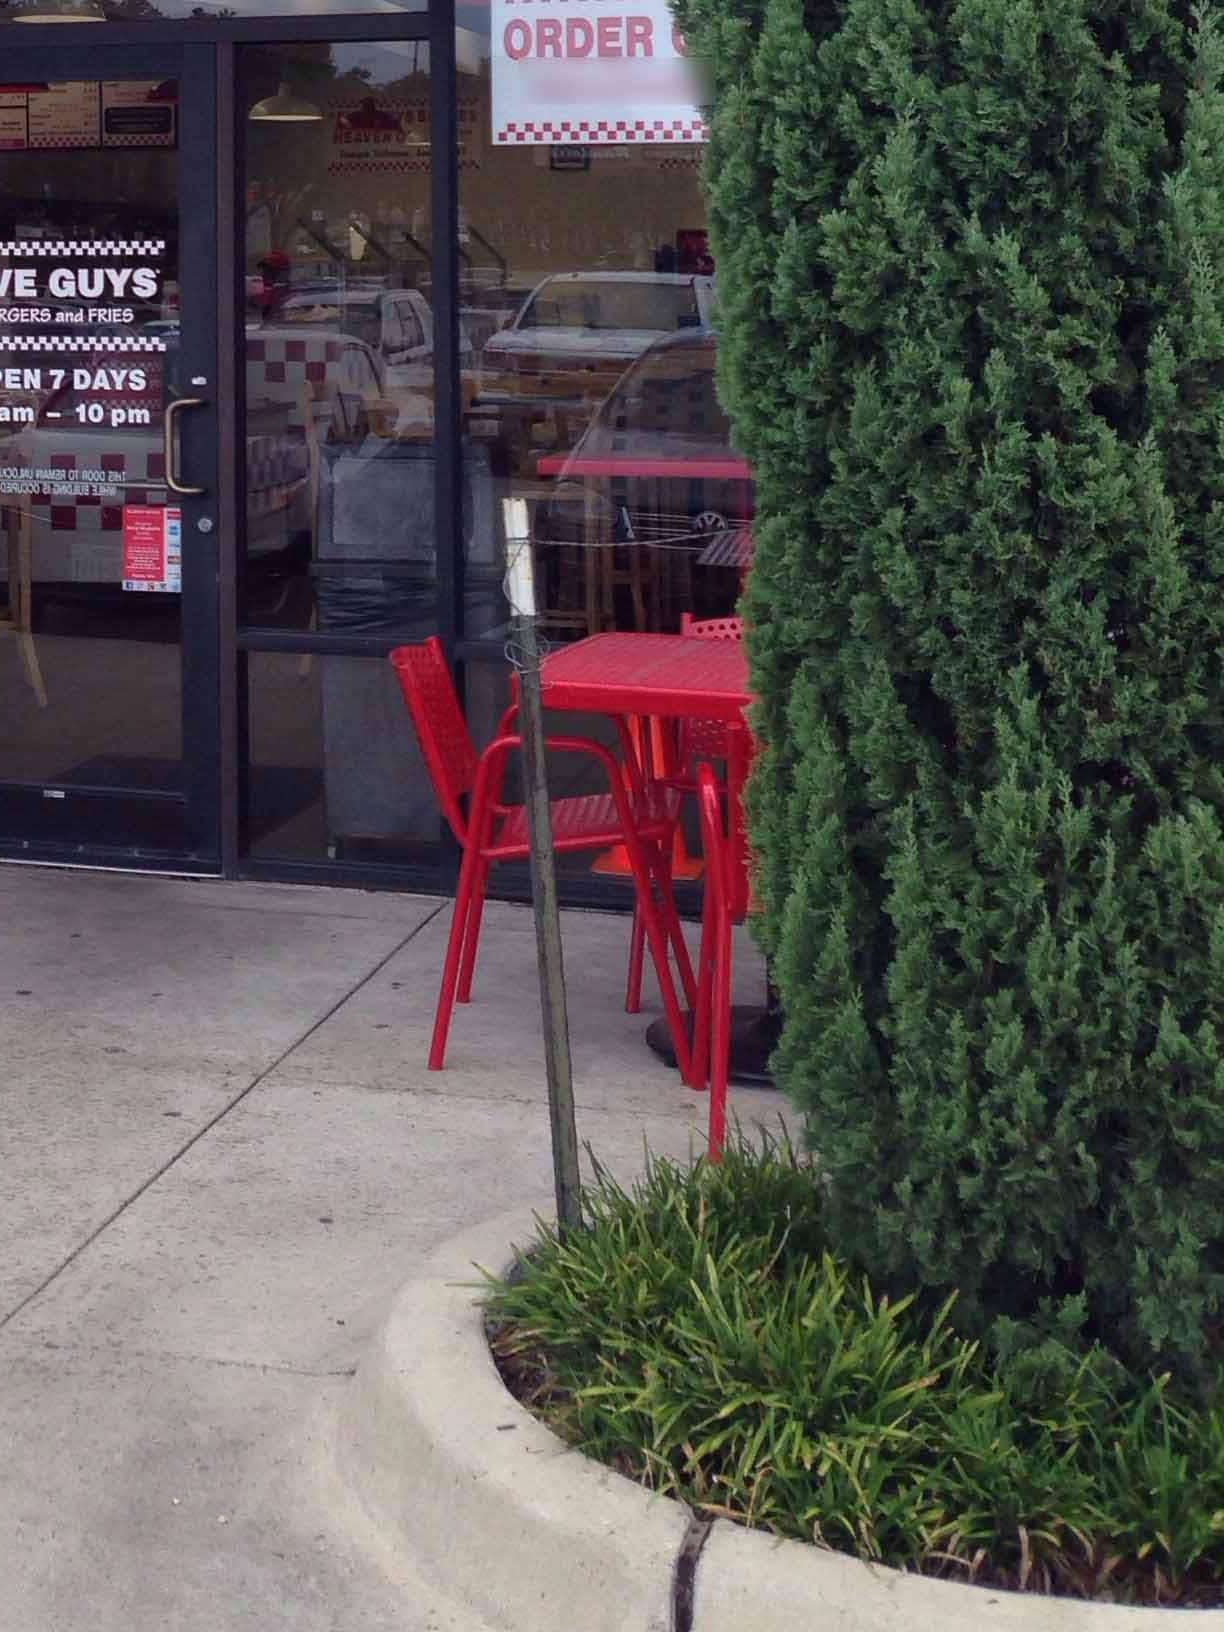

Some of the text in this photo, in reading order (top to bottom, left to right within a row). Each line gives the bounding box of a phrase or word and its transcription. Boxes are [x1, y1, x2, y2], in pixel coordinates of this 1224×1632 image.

[503, 16, 654, 61] ORDER
[48, 267, 159, 298] GUYS
[55, 308, 83, 323] and
[88, 307, 134, 323] FRIES
[50, 368, 65, 390] 7
[72, 368, 147, 391] DAYS
[75, 403, 104, 422] 10
[110, 407, 151, 426] pm
